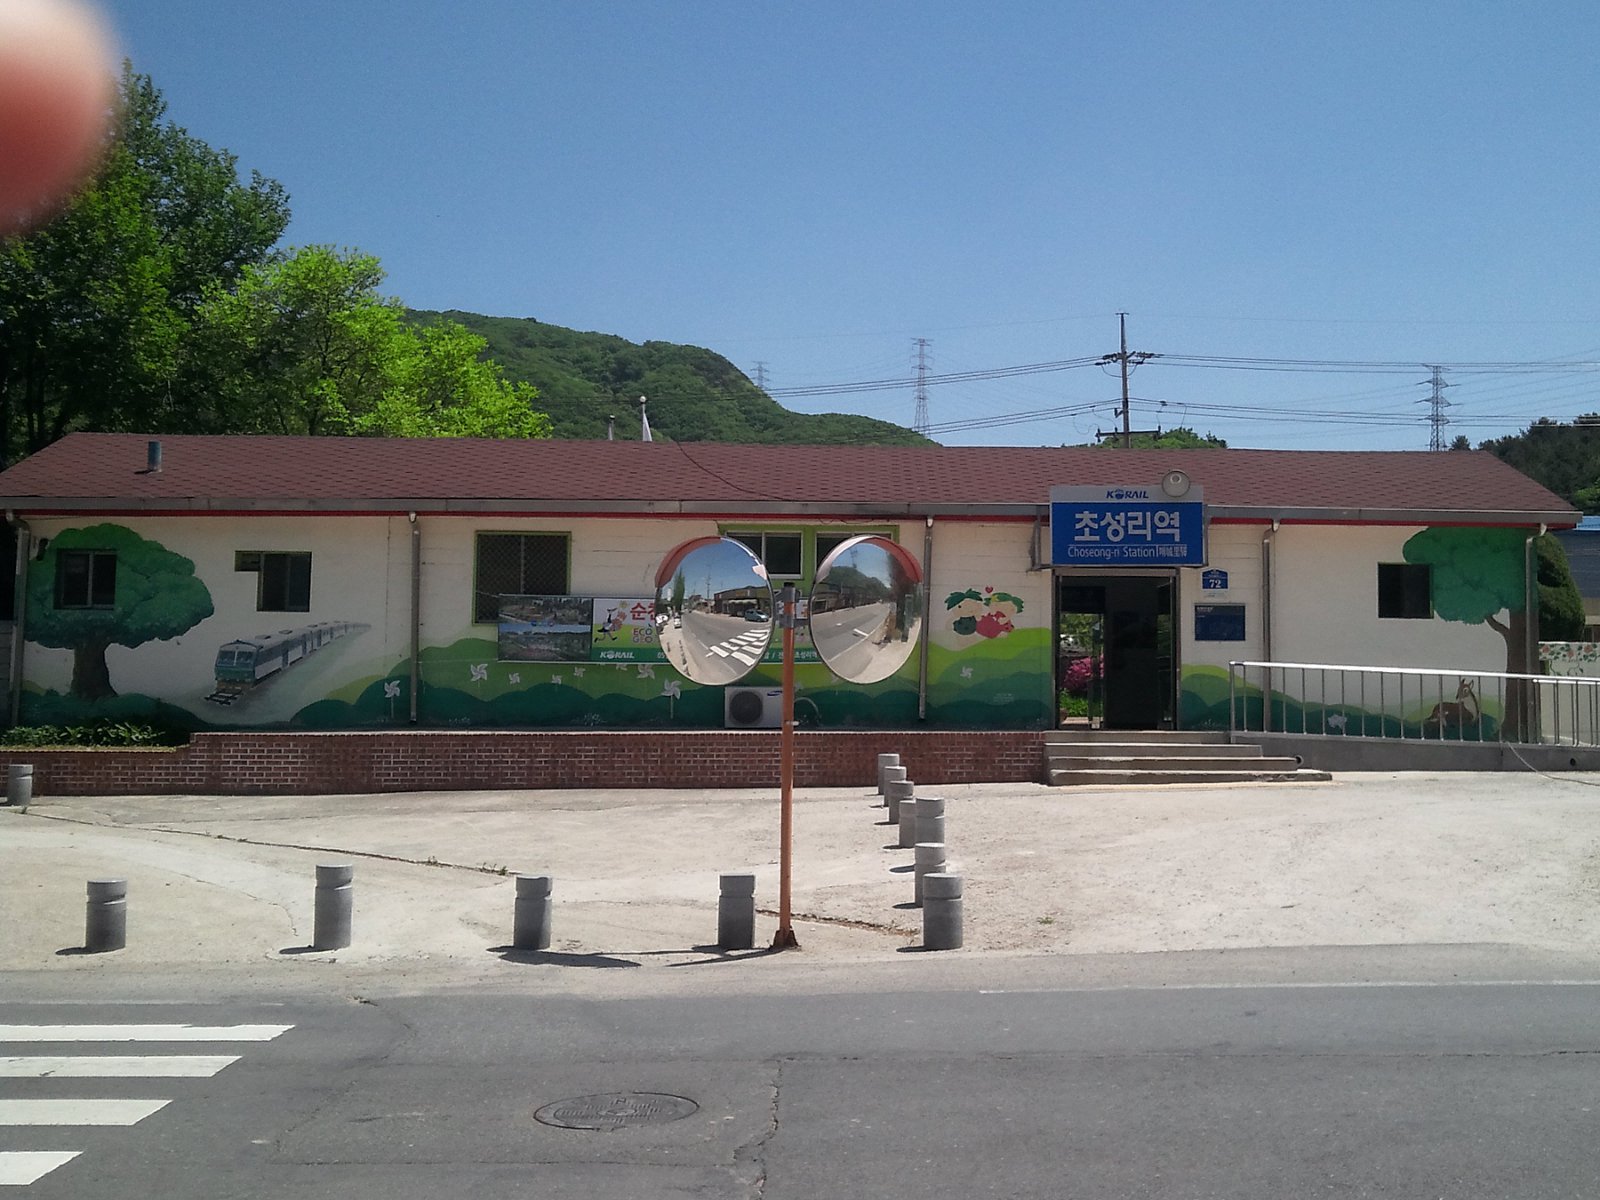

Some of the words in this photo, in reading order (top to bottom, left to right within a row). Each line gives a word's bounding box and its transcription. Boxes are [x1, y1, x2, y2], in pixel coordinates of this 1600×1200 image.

[1106, 489, 1149, 499] KORAIL
[1074, 511, 1180, 542] 초성리역
[1123, 546, 1156, 557] Station
[1209, 580, 1221, 588] 72
